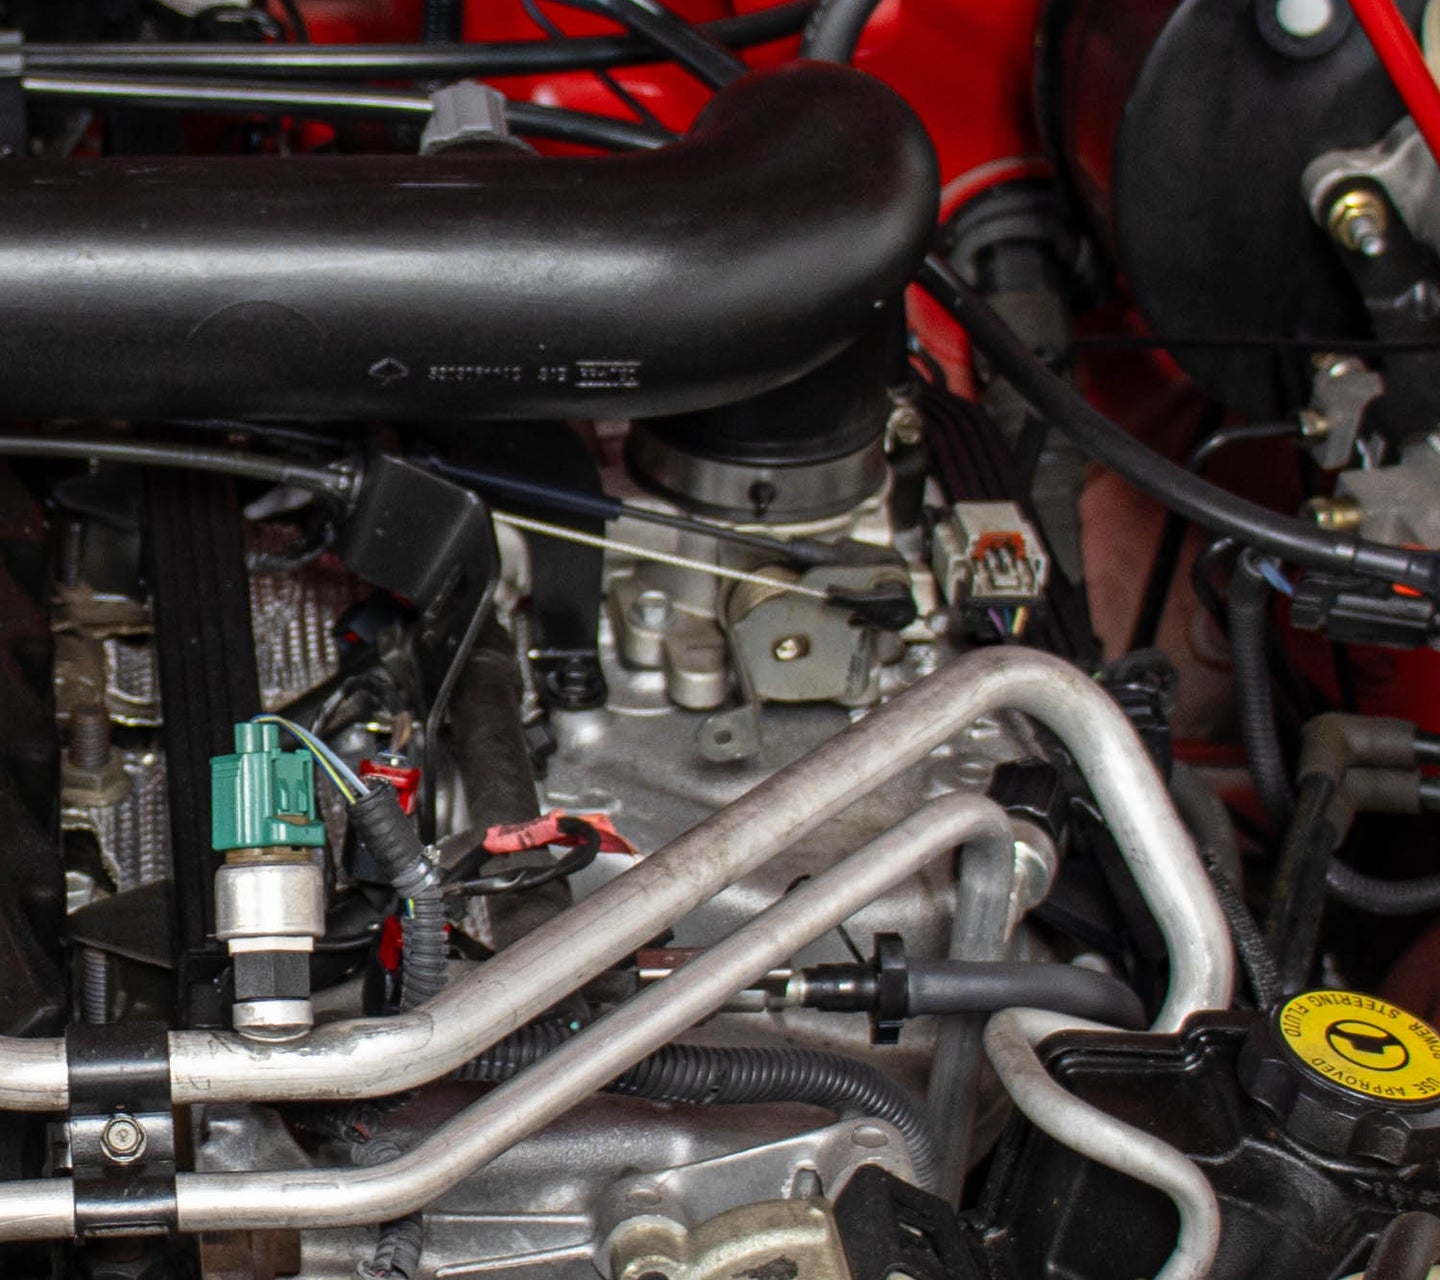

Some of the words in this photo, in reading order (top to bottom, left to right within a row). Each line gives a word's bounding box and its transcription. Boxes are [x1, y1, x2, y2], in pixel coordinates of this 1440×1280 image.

[1283, 1001, 1310, 1038] FLUID
[1307, 992, 1402, 1020] STEERING
[1311, 1056, 1407, 1097] APPROVED
